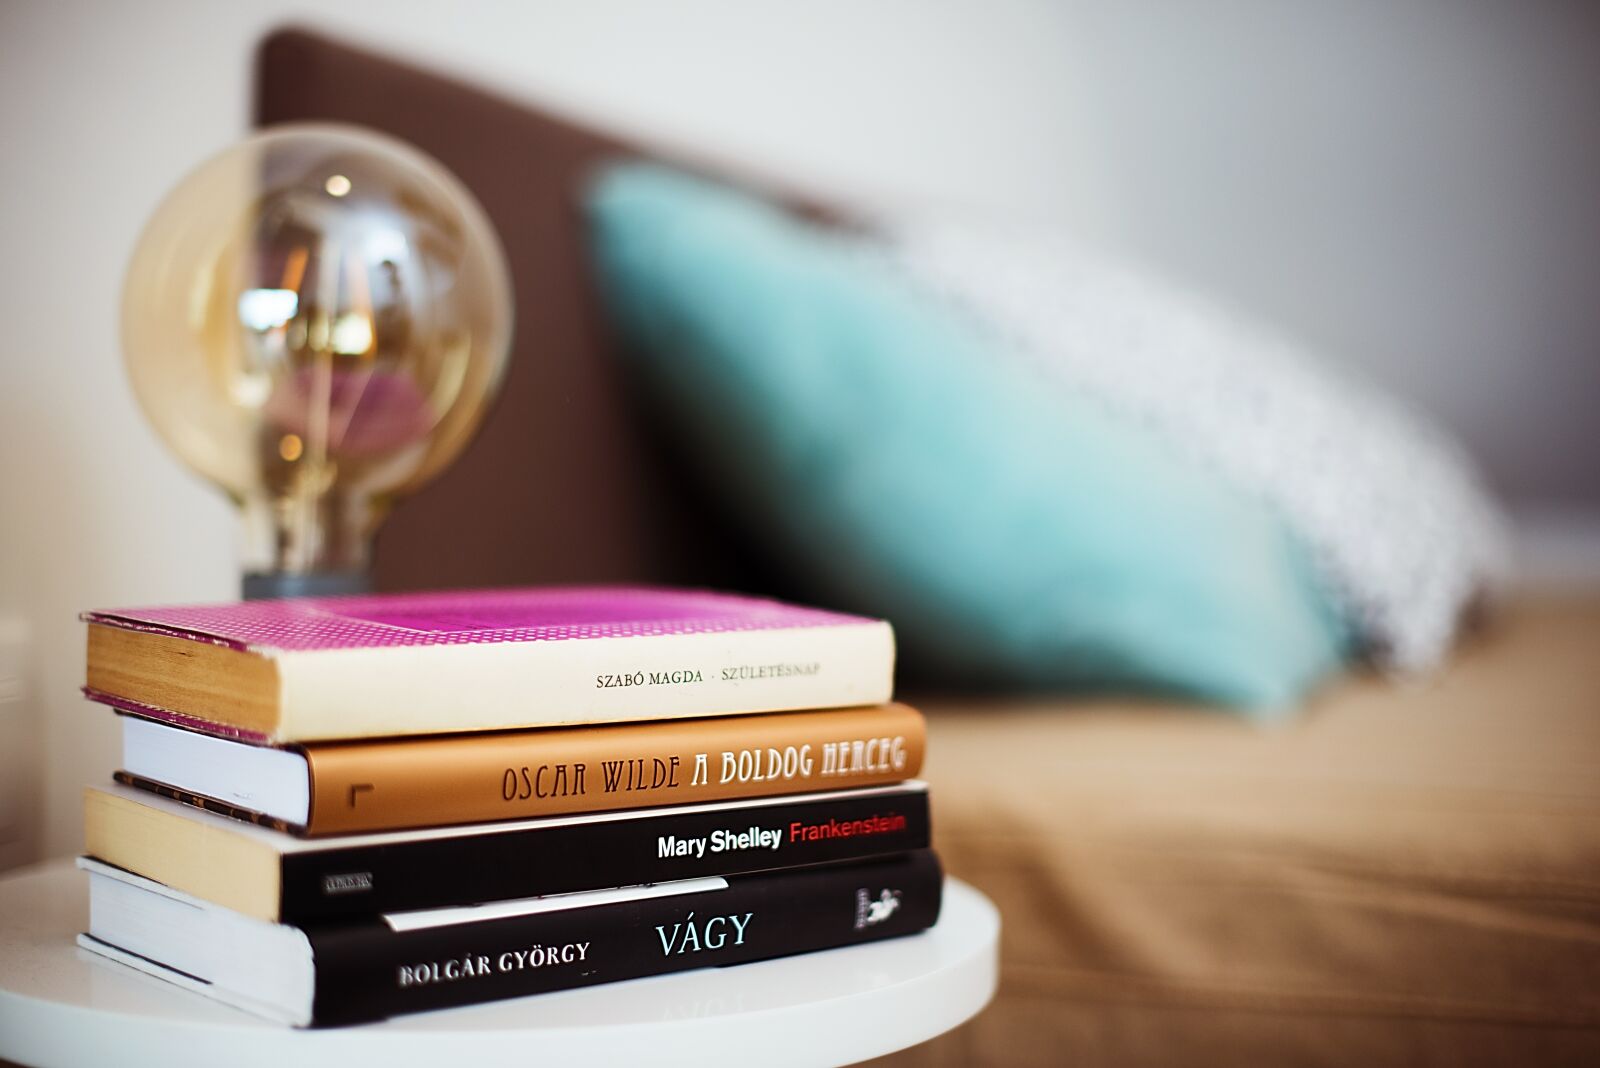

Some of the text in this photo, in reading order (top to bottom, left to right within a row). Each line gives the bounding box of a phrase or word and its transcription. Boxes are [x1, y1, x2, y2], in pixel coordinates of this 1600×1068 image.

[596, 663, 821, 688] SZABÓ MAGDA SZÜLETÉSNAP
[502, 736, 906, 801] OSCAR WILDE A BOLDOG HERCEG
[658, 813, 906, 859] Mary Shelley Frankenstein
[399, 911, 754, 988] BOLGÁR GYÖRGY VÁGY
